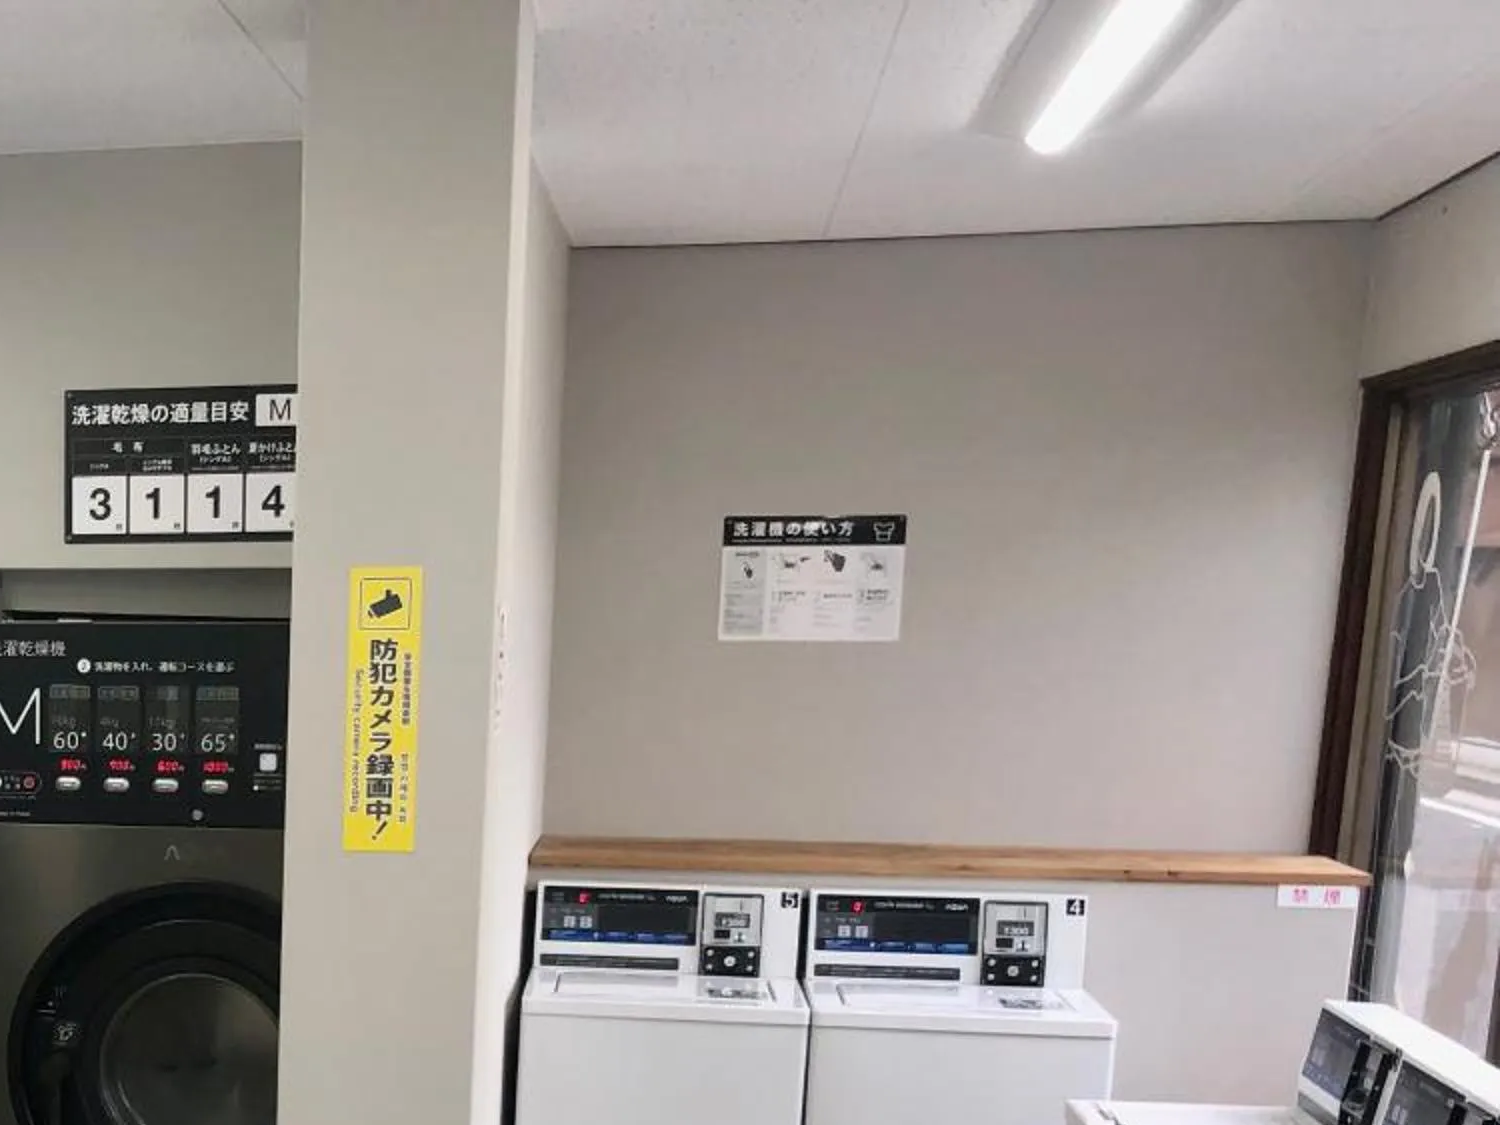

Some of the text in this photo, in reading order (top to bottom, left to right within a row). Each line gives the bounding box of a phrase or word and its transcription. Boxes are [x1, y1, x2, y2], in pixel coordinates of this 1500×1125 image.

[71, 399, 291, 426] 洗濯乾燥の適量目安 M
[89, 487, 112, 521] 3
[145, 487, 161, 520] 1
[205, 485, 221, 519] 1
[261, 484, 285, 518] 4
[365, 638, 399, 840] 防犯カメラ録画中!
